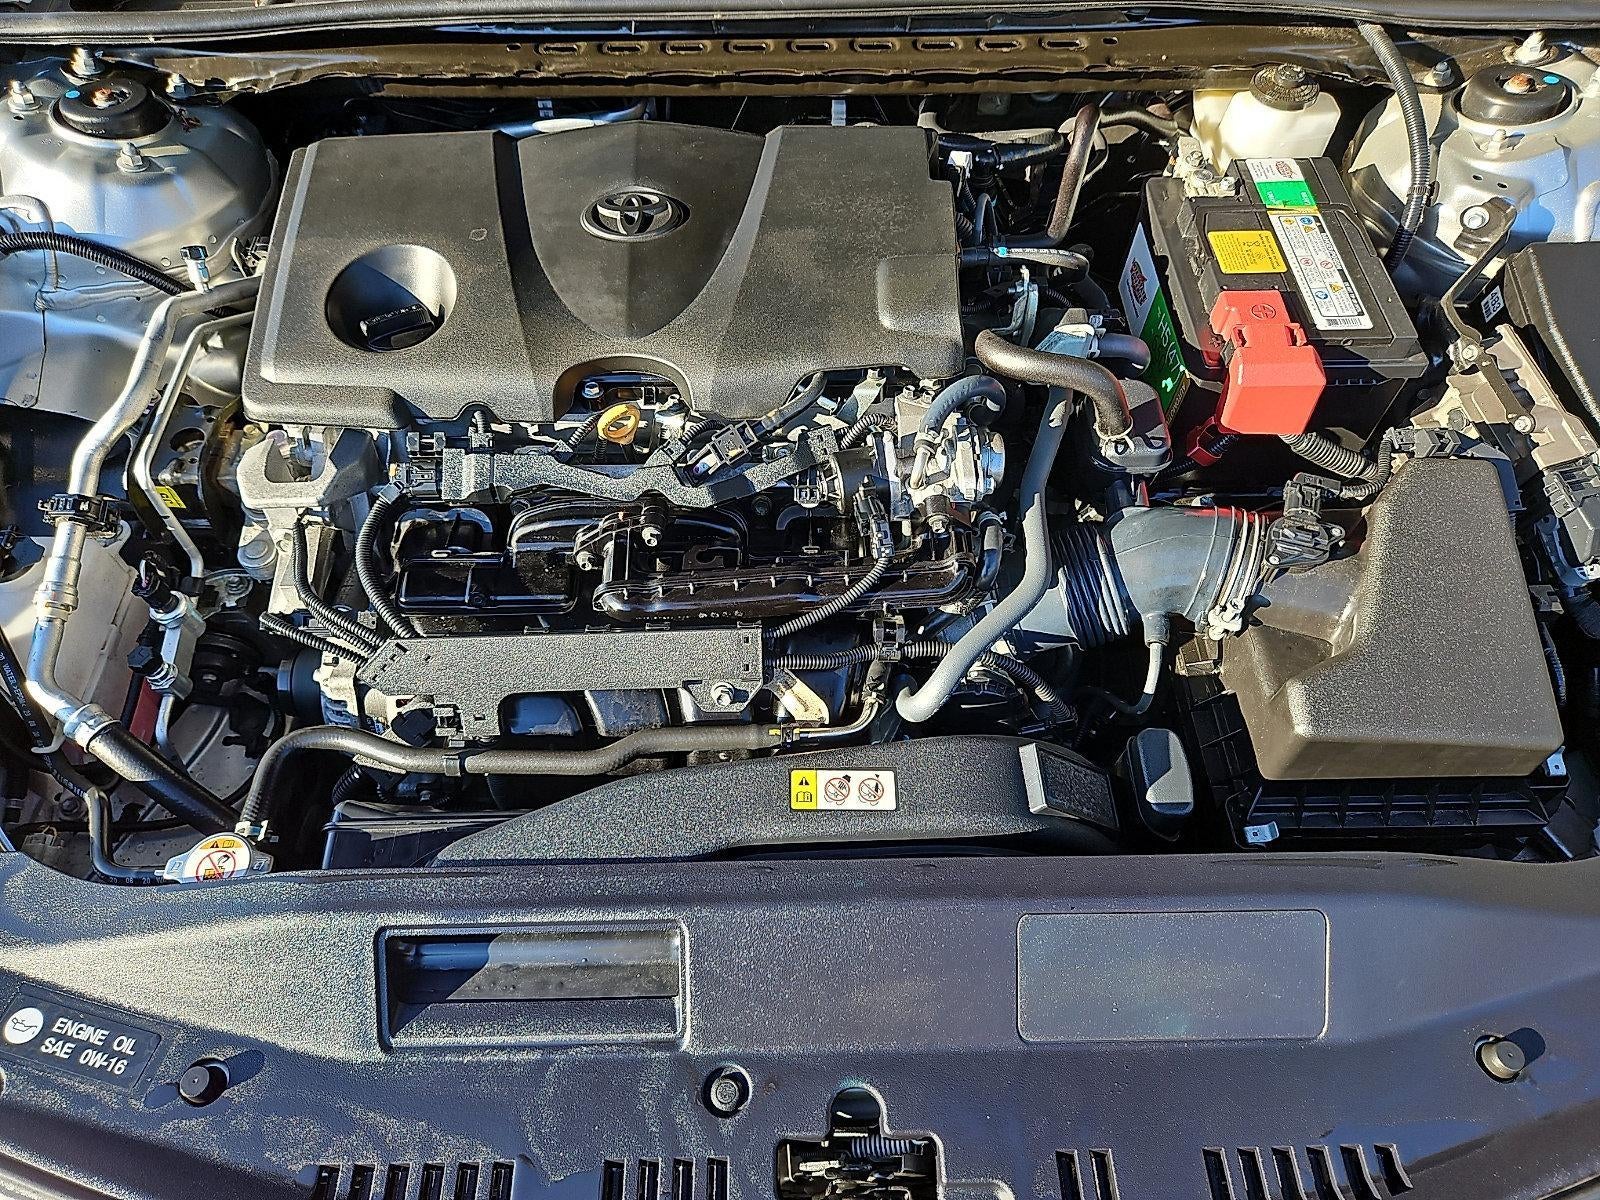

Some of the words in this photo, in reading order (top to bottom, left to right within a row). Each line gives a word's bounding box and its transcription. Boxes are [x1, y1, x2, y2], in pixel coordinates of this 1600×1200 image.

[3, 663, 17, 685] WATER
[52, 1017, 110, 1046] ENGINE
[112, 1035, 137, 1056] OIL
[40, 1037, 76, 1059] SAE
[79, 1048, 128, 1075] 0W-16
